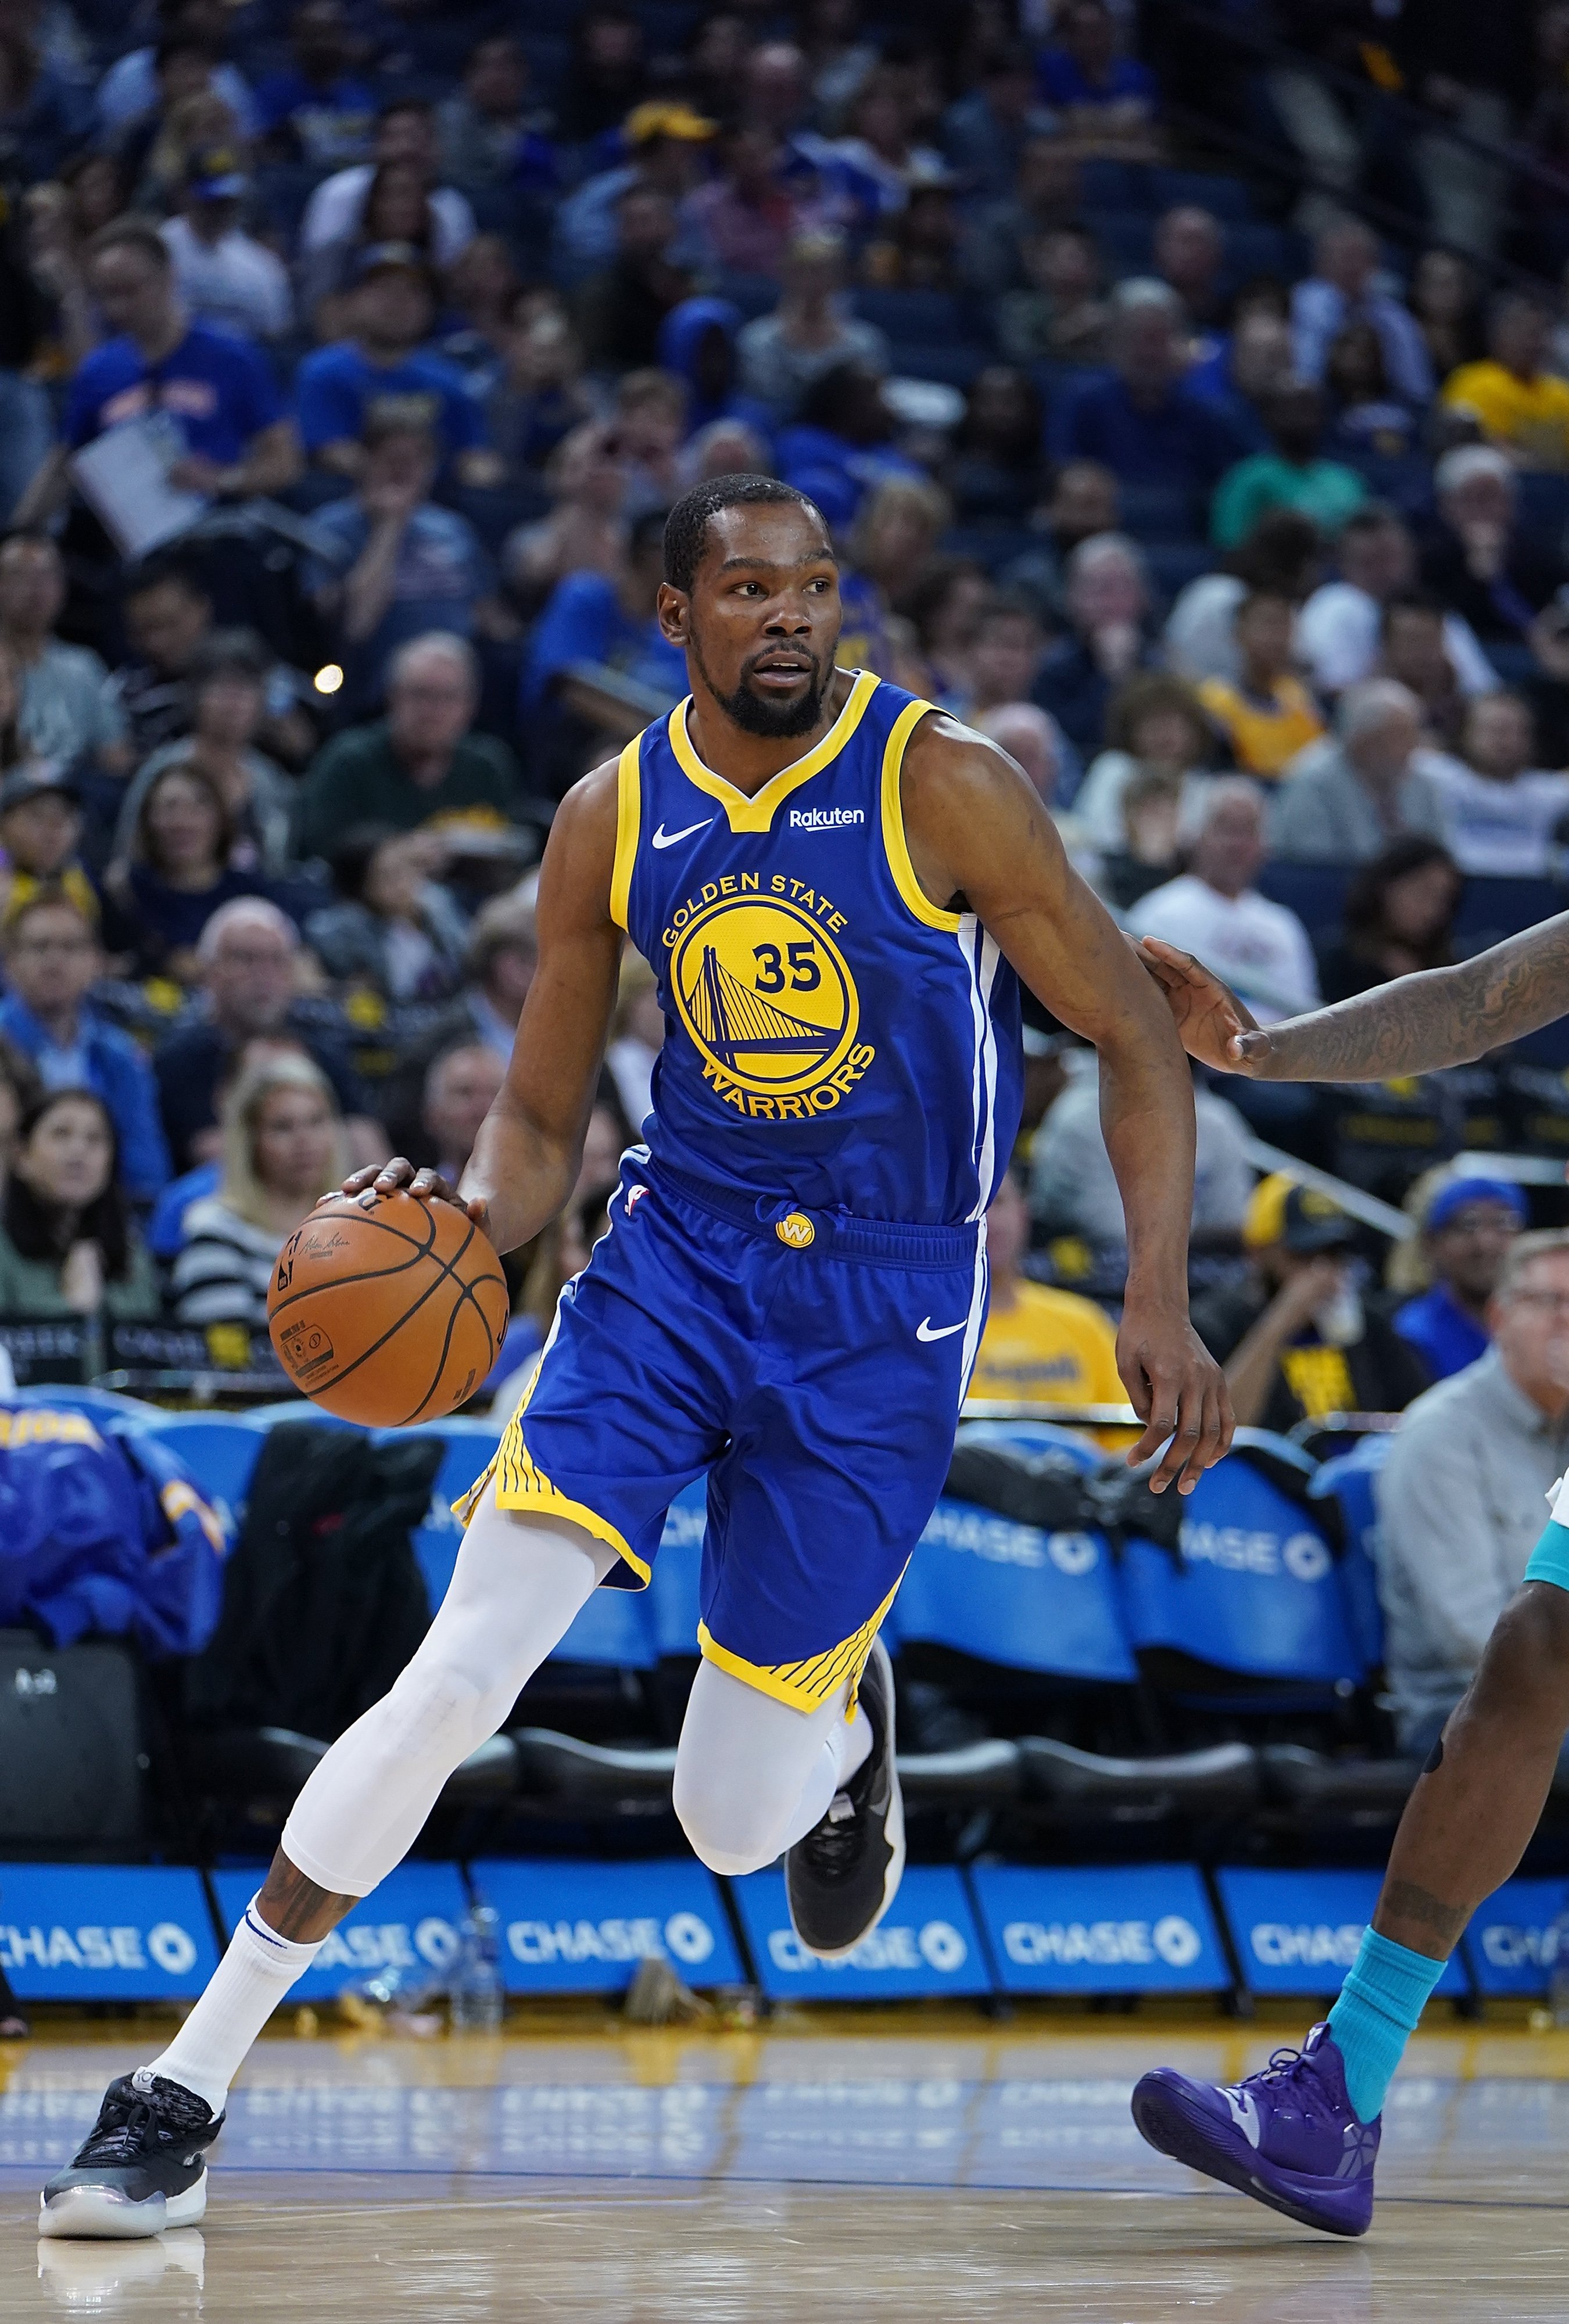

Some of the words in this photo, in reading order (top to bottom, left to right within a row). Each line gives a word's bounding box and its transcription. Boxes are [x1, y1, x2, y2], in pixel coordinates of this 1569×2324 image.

[790, 808, 865, 827] Rakuten
[661, 872, 760, 949] GOLDEN
[771, 874, 848, 934] STATE
[752, 939, 821, 994] 35
[701, 1042, 876, 1120] WARRIORS
[782, 1220, 812, 1242] W
[312, 1924, 415, 1970] ASE
[507, 1918, 667, 1963] CHASE
[1003, 1920, 1155, 1966] CHASE
[1251, 1923, 1367, 1966] CHAS
